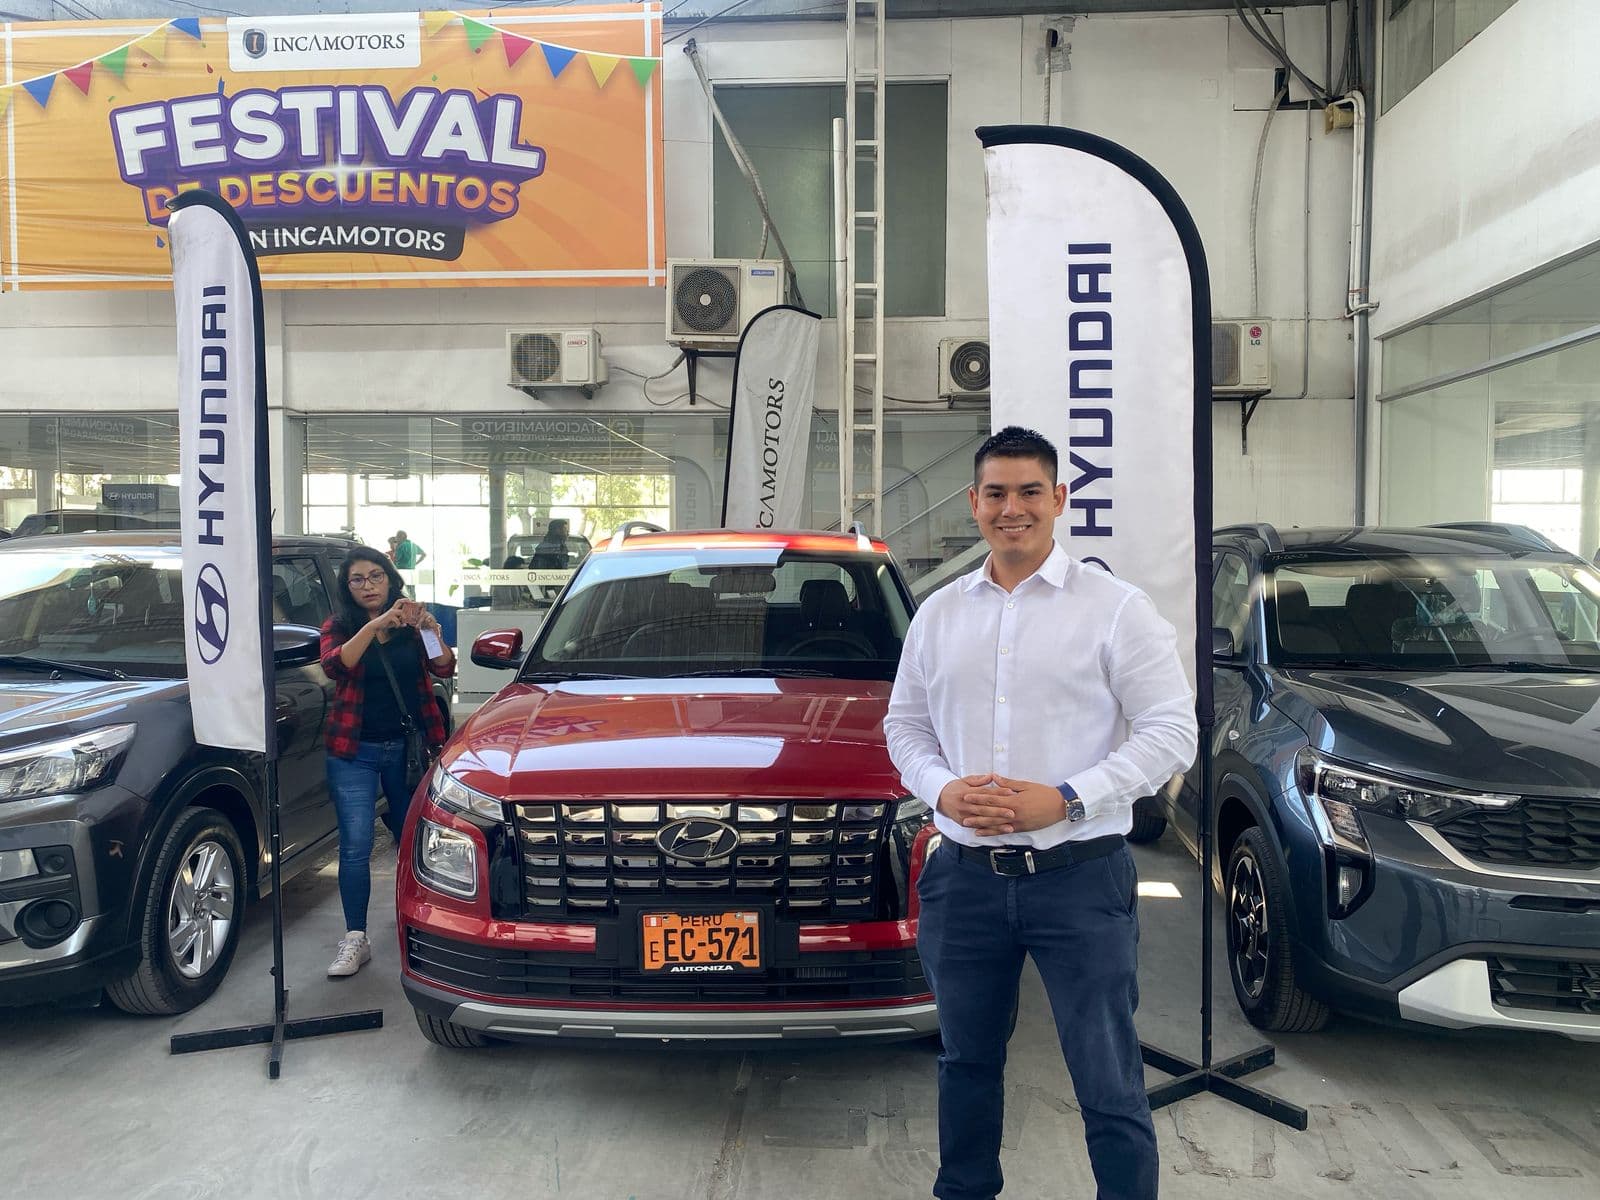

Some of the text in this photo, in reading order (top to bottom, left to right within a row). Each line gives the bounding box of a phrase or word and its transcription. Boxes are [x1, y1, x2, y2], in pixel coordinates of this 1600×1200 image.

[273, 34, 405, 52] INCAMOTORS
[114, 90, 541, 176] FESTIVAL
[146, 171, 518, 219] D DESCUENTOS
[249, 225, 446, 251] N INCAMOTORS
[1068, 243, 1113, 537] HYUNDAI
[198, 286, 228, 546] HYUNDAI
[758, 378, 785, 528] CAMOTORS
[121, 492, 155, 500] HYUNDAI
[680, 916, 722, 927] PERU
[650, 926, 757, 962] E EC-571
[670, 964, 734, 973] AUTONIZA
